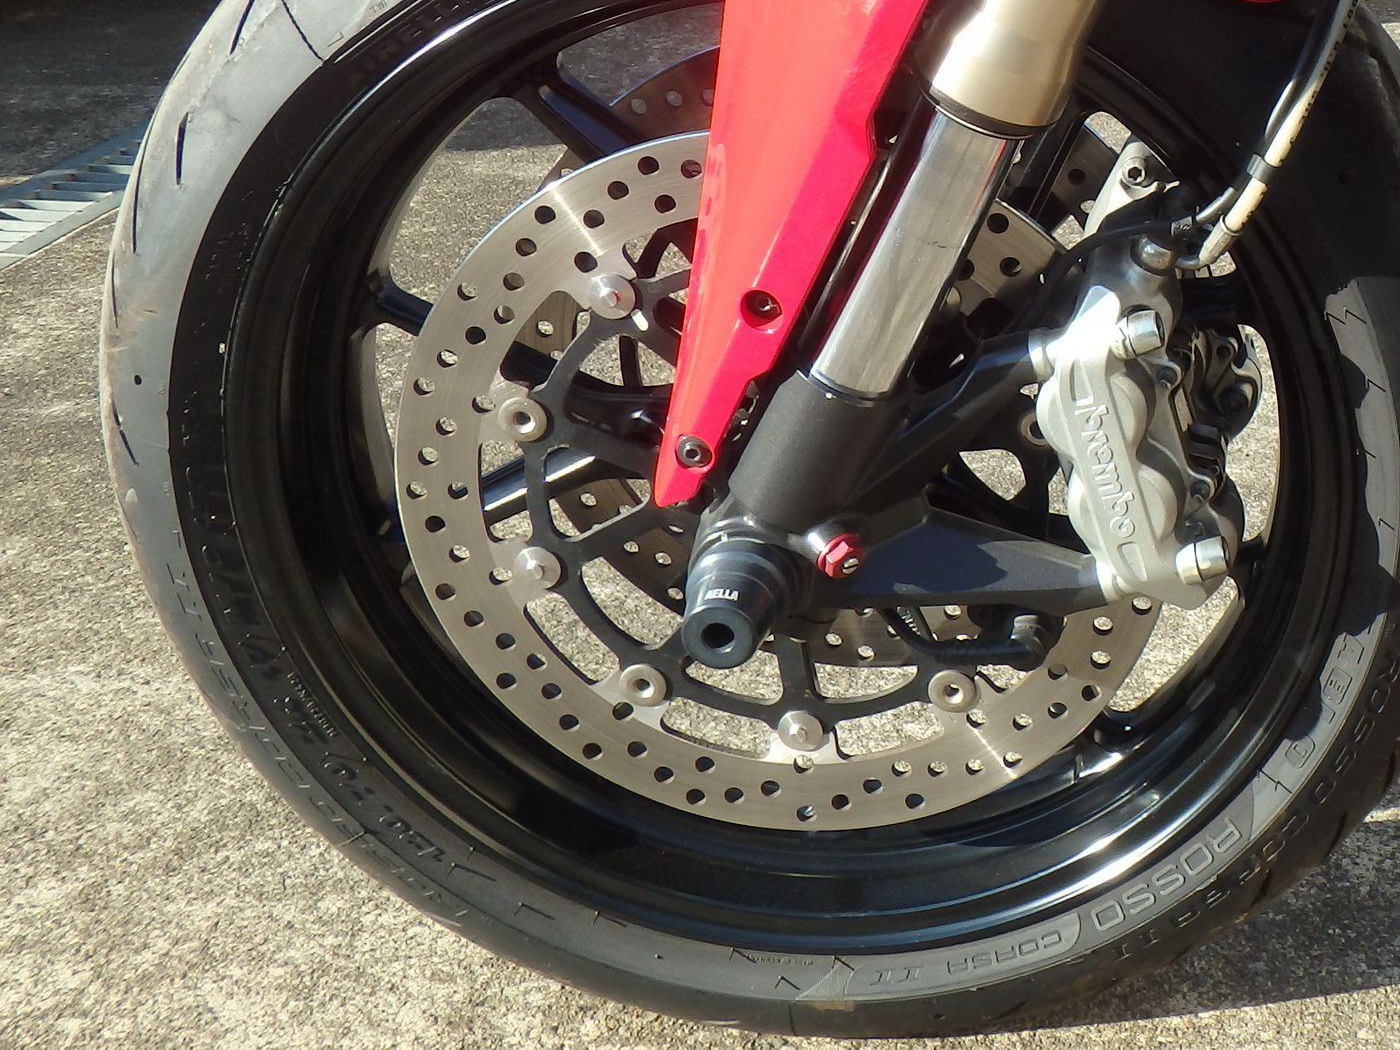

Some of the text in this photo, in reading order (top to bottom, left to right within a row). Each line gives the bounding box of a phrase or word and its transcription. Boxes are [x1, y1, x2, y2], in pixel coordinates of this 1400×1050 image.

[369, 0, 388, 15] TWI
[1075, 405, 1136, 538] brembo
[1090, 817, 1242, 932] ROSSO
[946, 929, 1062, 975] CORSA
